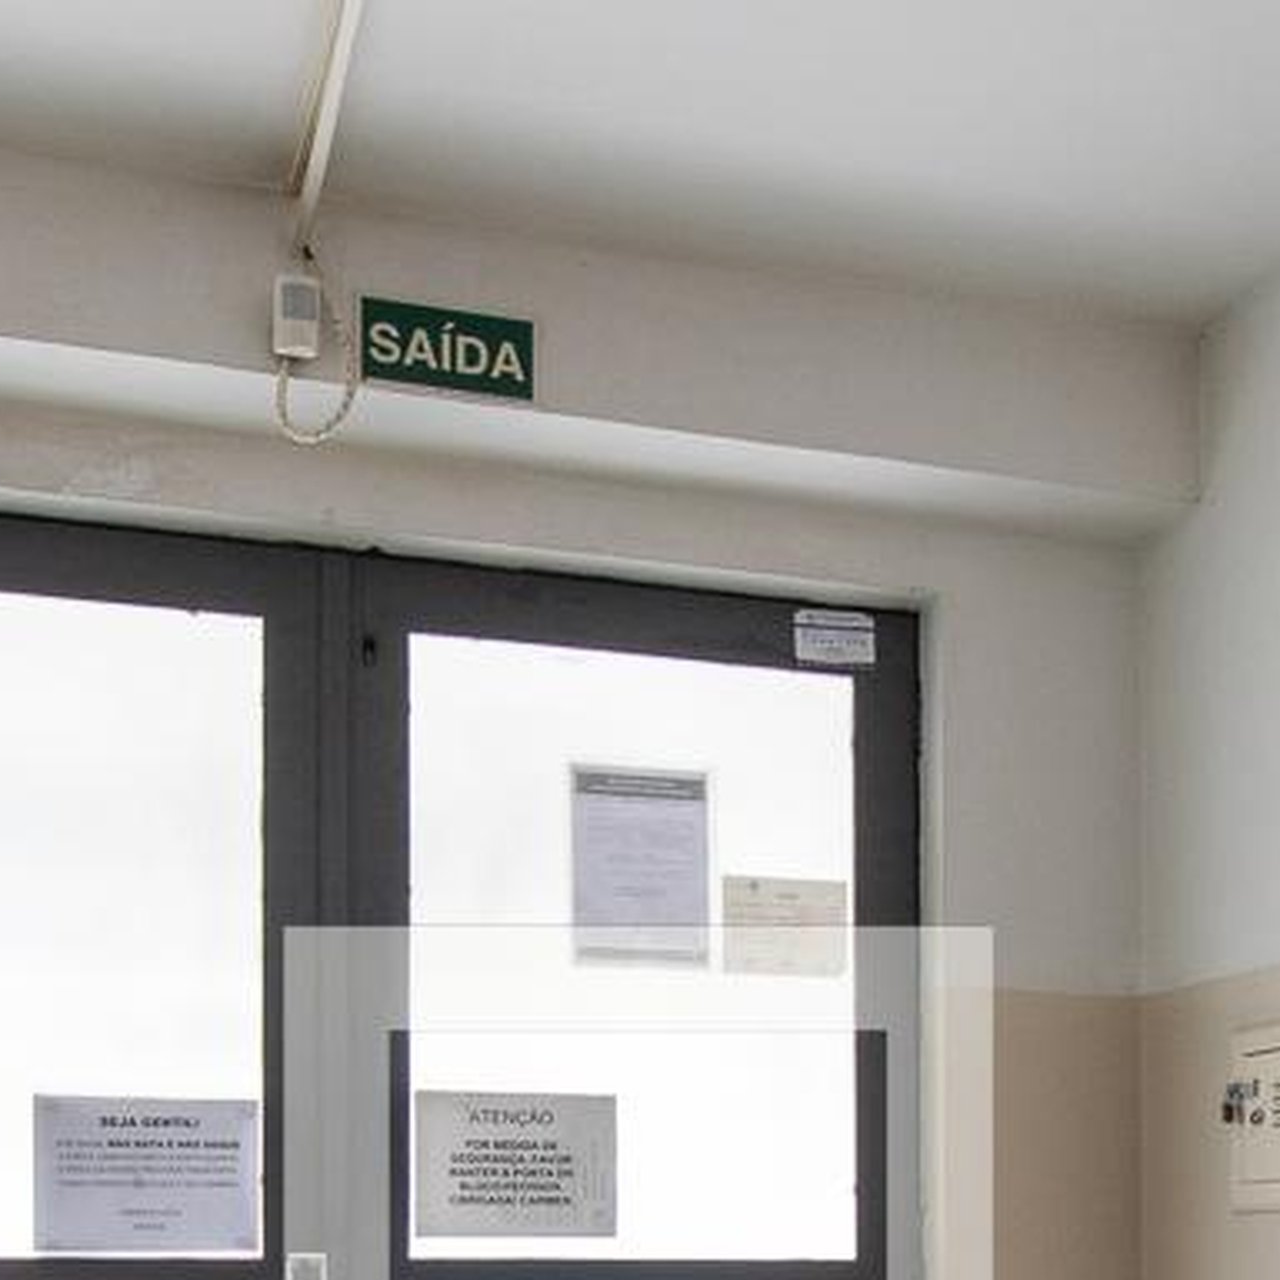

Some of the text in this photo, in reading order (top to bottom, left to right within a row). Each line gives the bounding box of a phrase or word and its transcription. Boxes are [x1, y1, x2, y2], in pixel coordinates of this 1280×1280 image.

[369, 321, 525, 381] SAÍDA
[100, 1115, 138, 1128] SEJA
[470, 1108, 555, 1126] ATENÇÃO
[465, 1139, 490, 1150] POR
[493, 1139, 540, 1151] MEDIDA
[449, 1167, 499, 1177] MANTER
[513, 1167, 554, 1178] PORTA
